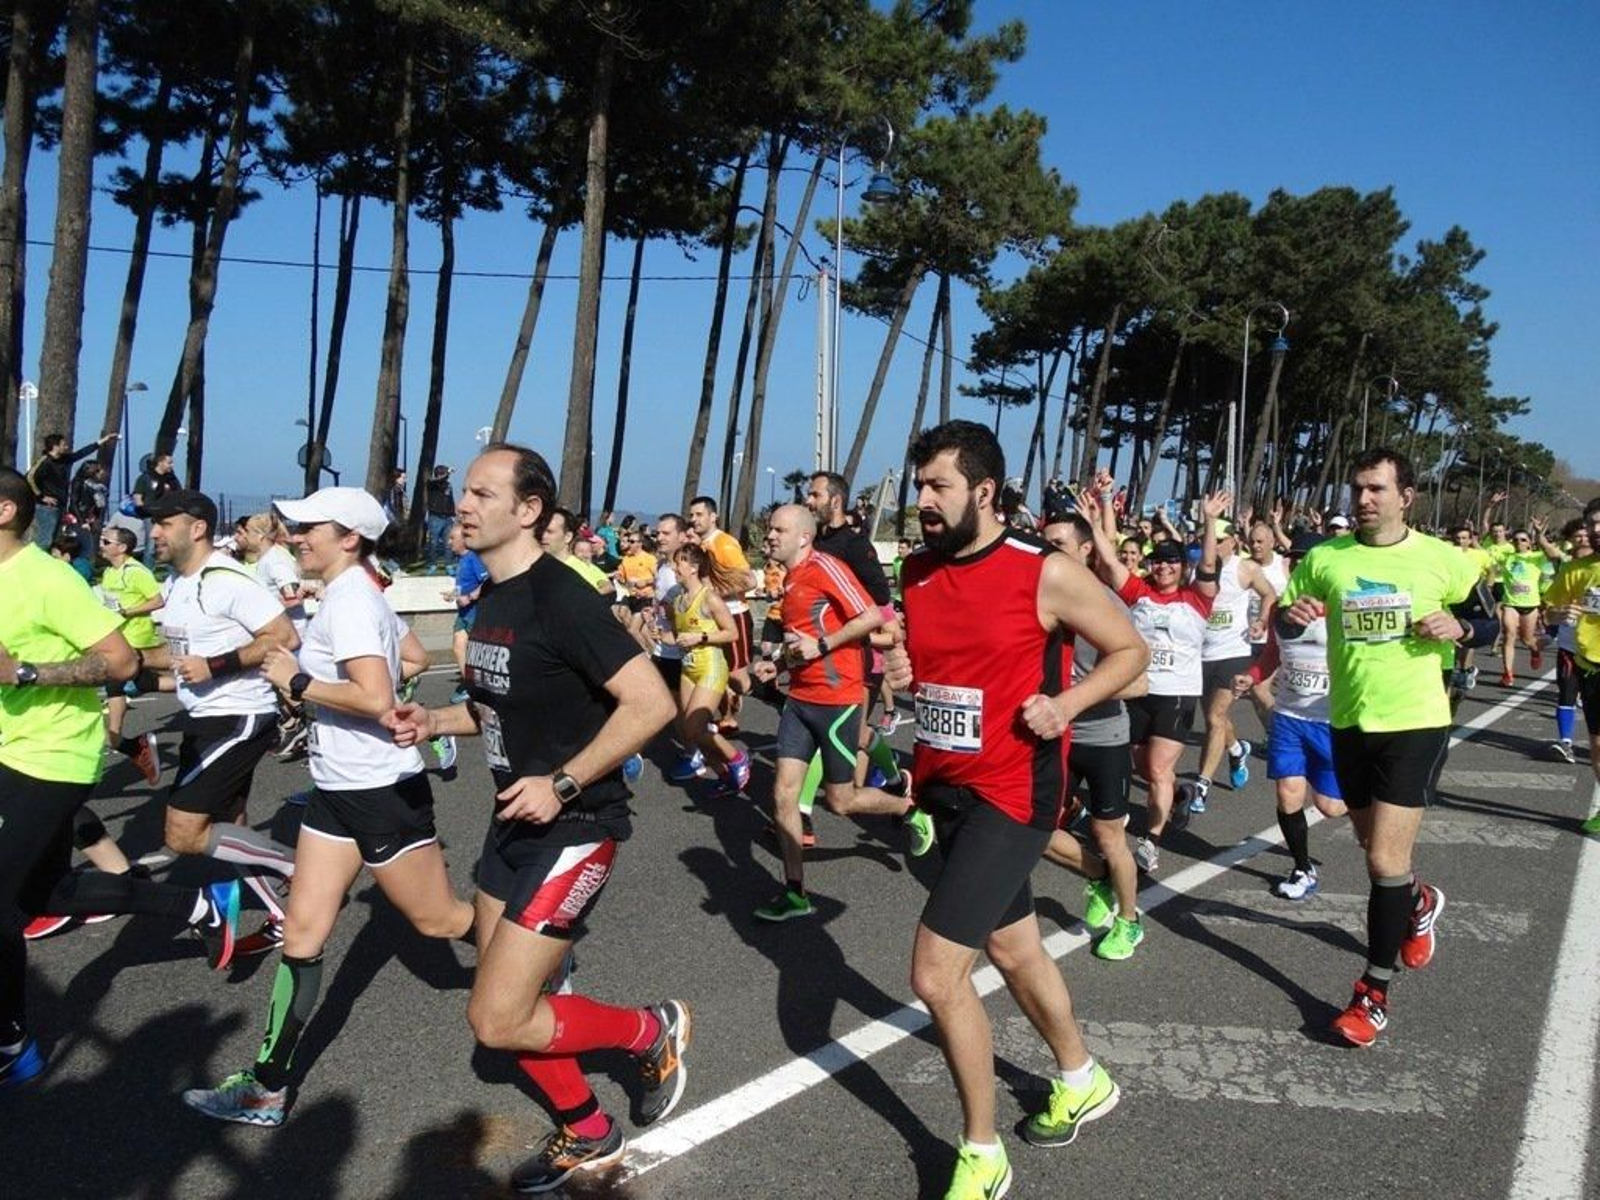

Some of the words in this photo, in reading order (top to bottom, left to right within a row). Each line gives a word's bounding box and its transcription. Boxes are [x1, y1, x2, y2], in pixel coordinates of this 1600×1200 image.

[1357, 610, 1397, 631] 1579
[1289, 671, 1320, 688] 2357
[921, 705, 966, 737] 3886
